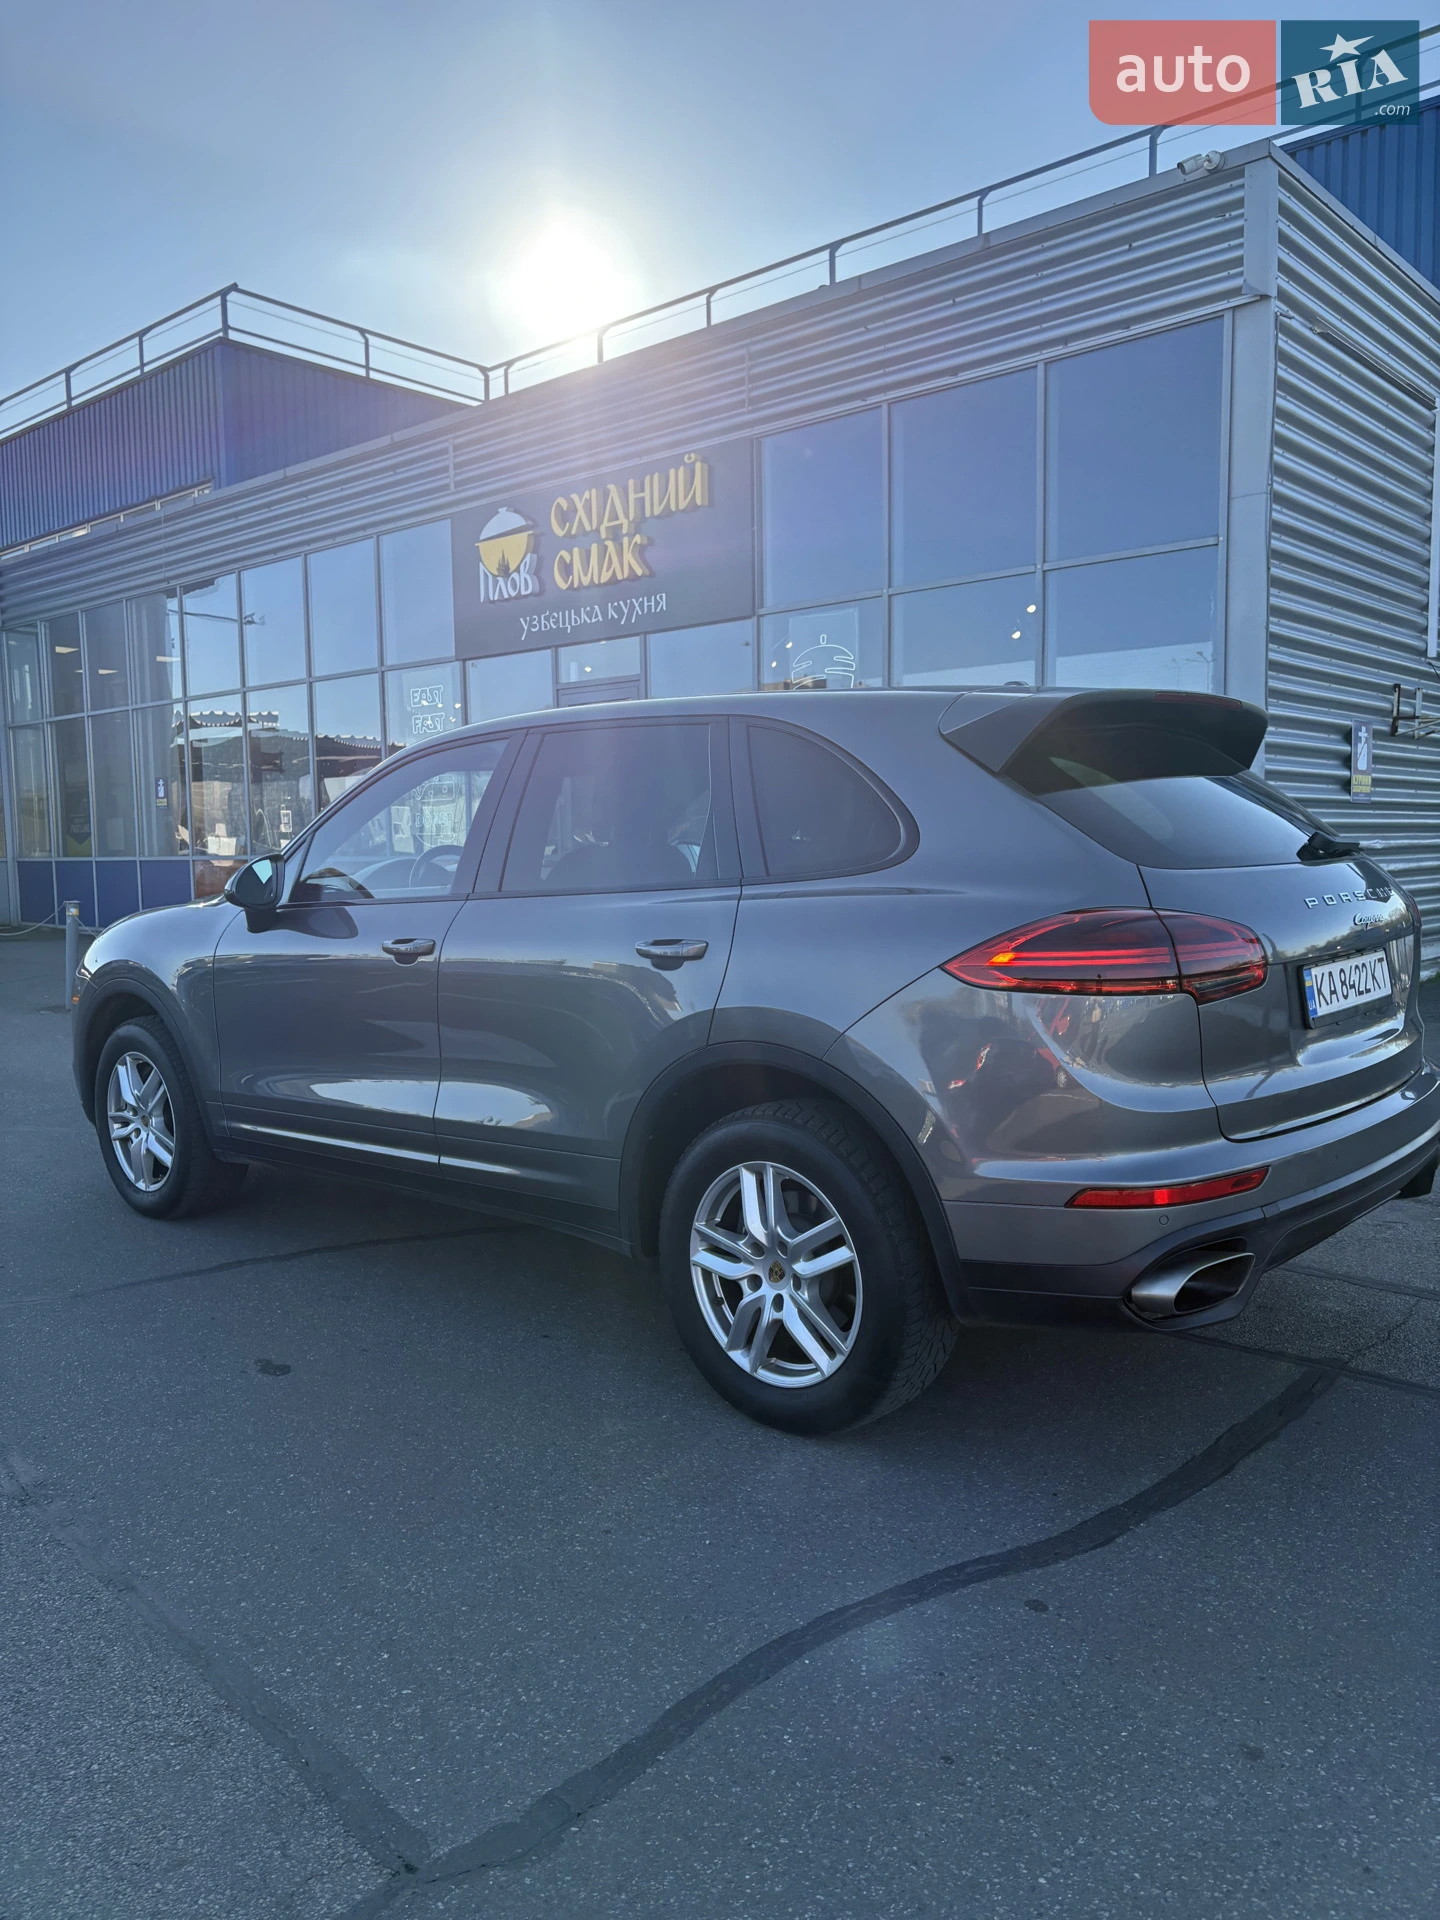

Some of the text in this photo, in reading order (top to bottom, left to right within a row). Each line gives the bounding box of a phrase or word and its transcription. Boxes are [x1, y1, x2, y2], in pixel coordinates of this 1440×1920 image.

[550, 453, 708, 539] СХІДНИЙ
[553, 534, 648, 590] СМАК
[607, 593, 667, 625] кухня
